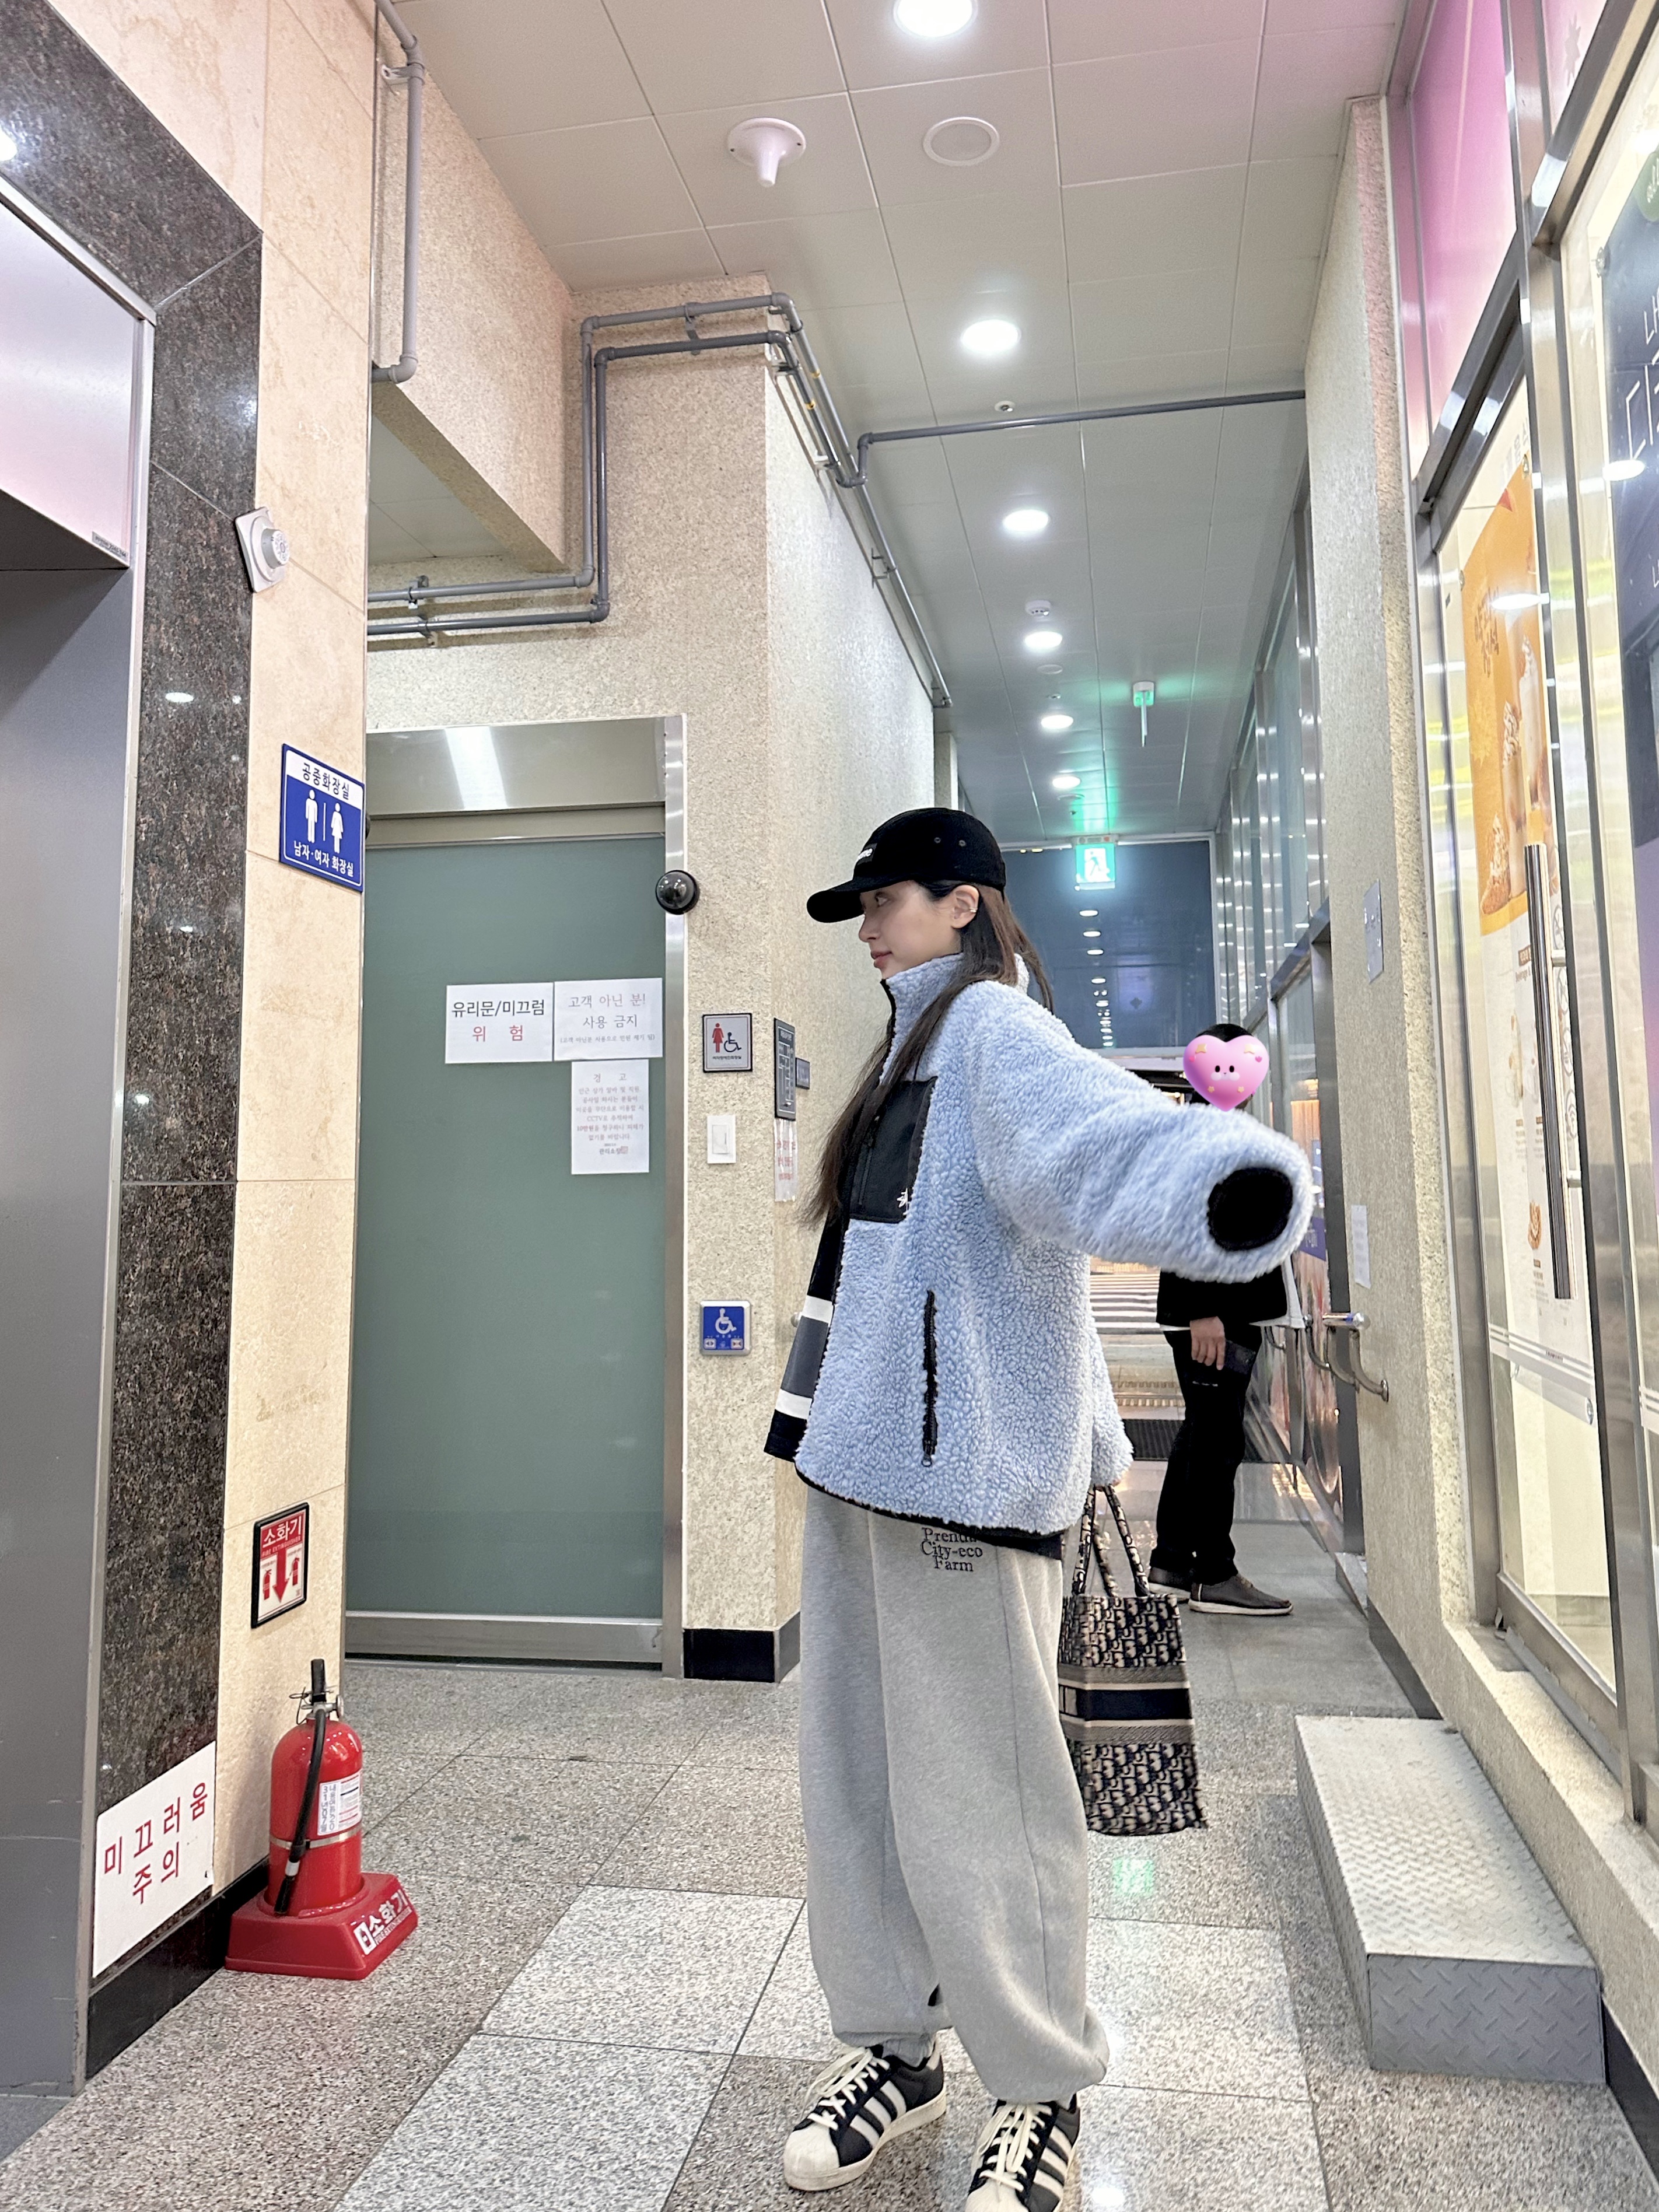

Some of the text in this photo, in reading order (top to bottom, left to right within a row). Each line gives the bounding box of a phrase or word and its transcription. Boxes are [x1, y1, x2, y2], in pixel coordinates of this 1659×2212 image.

[302, 762, 349, 800] 공중화장실
[294, 840, 354, 877] 남자·여자 화장실
[452, 999, 545, 1018] 유리문/미끄럼
[568, 993, 646, 1009] 고객 아닌 분!
[583, 1014, 638, 1029] 사용 금지
[262, 1516, 302, 1548] 소화기
[921, 1541, 983, 1559] City-eco
[933, 1556, 974, 1572] Farm
[104, 1782, 208, 1874] 미끄러움
[132, 1841, 180, 1905] 주의
[369, 1889, 409, 1937] 소화기
